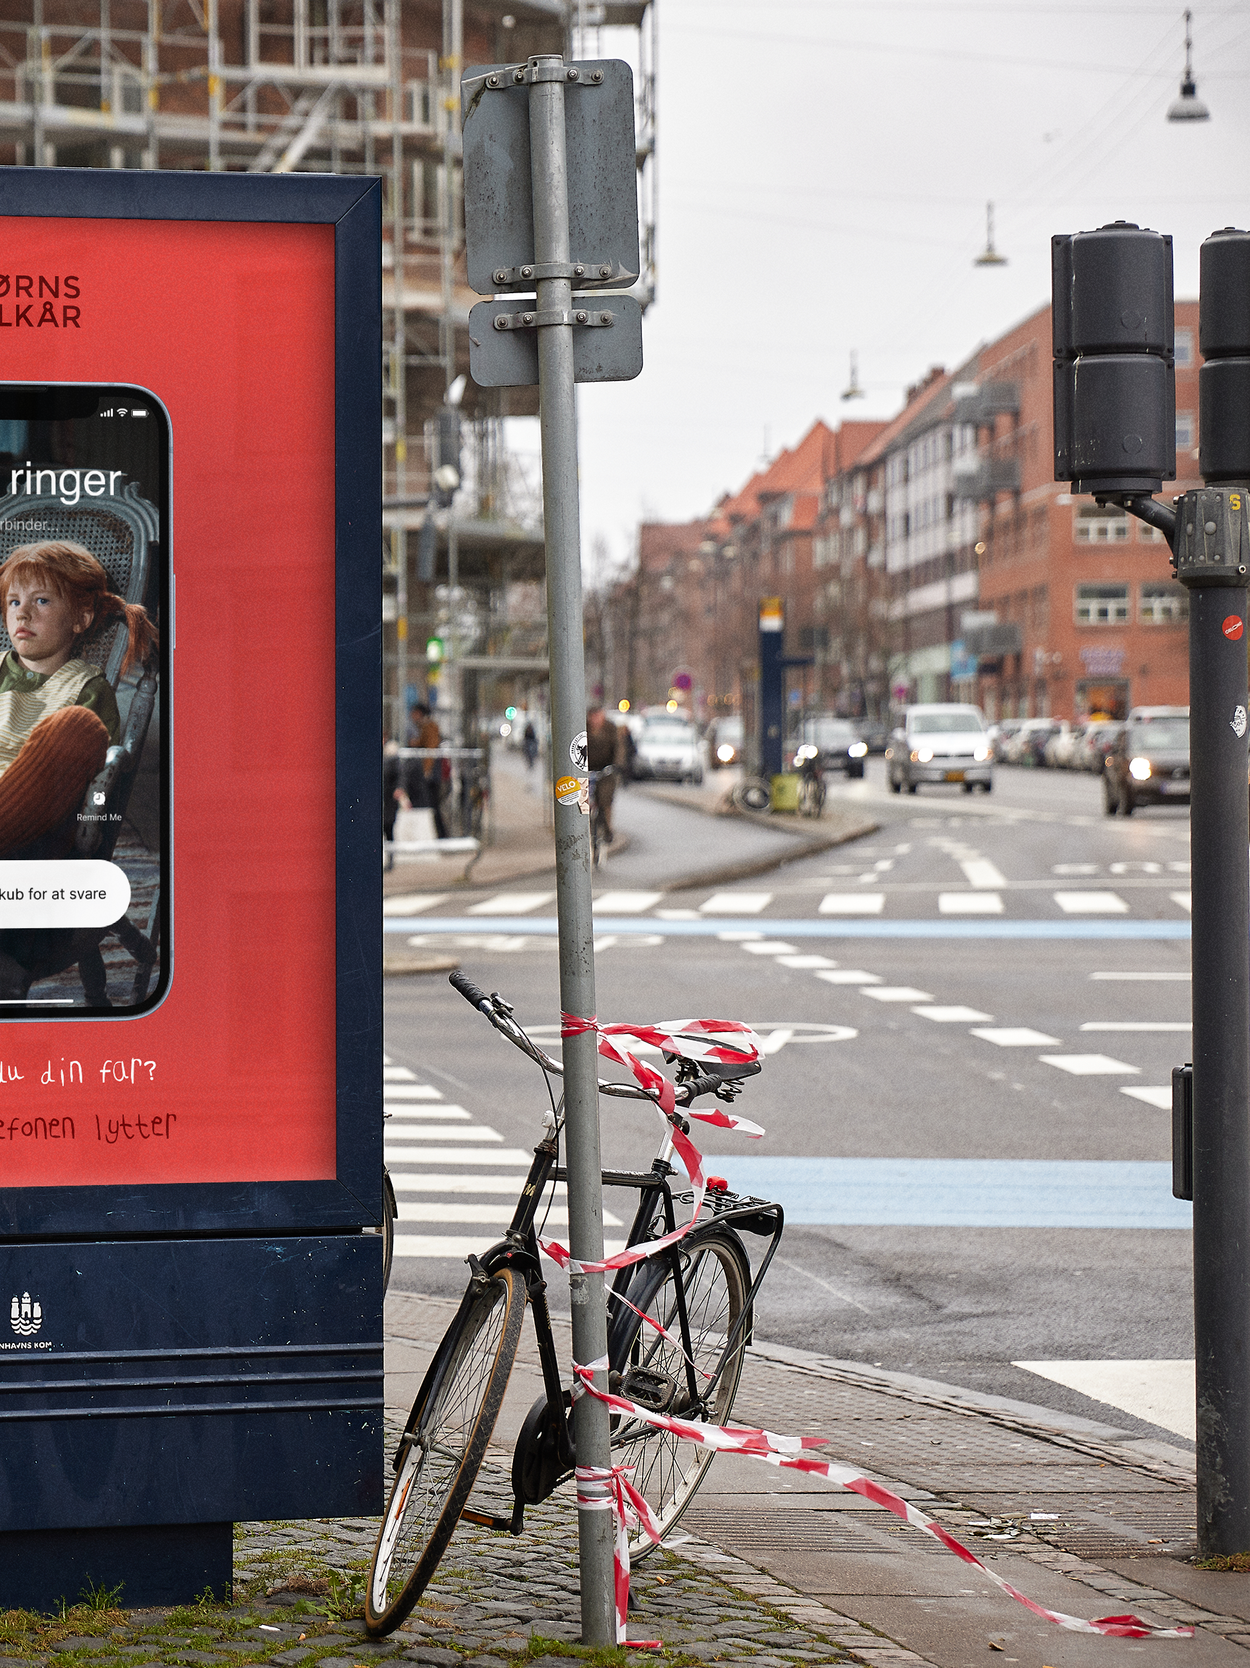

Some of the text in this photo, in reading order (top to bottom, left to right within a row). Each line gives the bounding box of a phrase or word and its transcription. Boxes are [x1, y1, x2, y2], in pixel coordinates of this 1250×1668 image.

[10, 460, 122, 506] ringer
[556, 780, 577, 794] VELO
[76, 812, 123, 823] Remind Me
[28, 887, 48, 901] for
[51, 888, 66, 900] at
[69, 888, 107, 900] svare
[40, 1057, 84, 1087] din
[99, 1057, 158, 1085] far?
[95, 1112, 177, 1145] lytter
